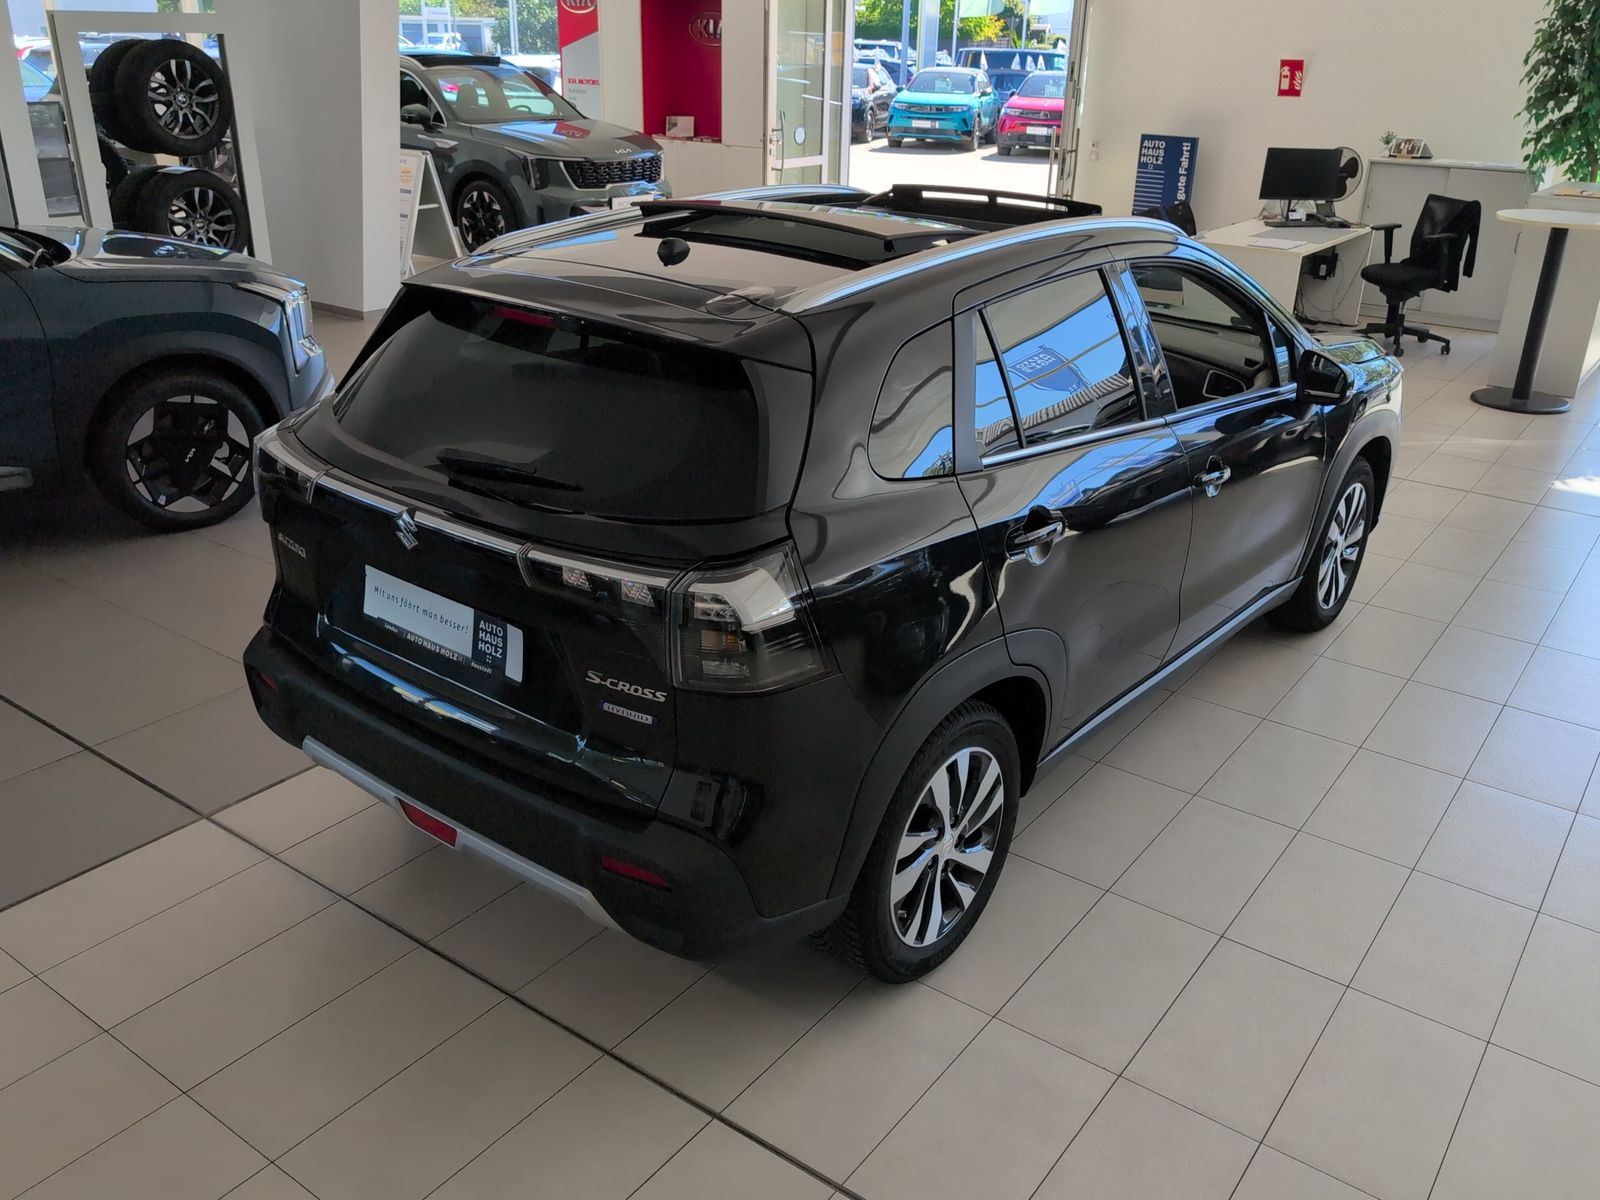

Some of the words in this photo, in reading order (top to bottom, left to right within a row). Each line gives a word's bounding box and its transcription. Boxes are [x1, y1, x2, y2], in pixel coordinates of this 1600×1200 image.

[1141, 147, 1165, 157] HAUS
[1142, 140, 1166, 149] AUTO
[1140, 156, 1163, 165] HOLZ
[1177, 175, 1187, 200] gute
[374, 585, 385, 598] Mit
[386, 593, 399, 604] uns
[421, 608, 438, 621] man
[440, 613, 469, 634] besser!
[479, 620, 503, 637] AUTO
[479, 630, 503, 647] HAUS
[440, 647, 458, 662] HOLZ
[478, 640, 503, 659] HOLZ
[585, 670, 668, 703] S-CROSS
